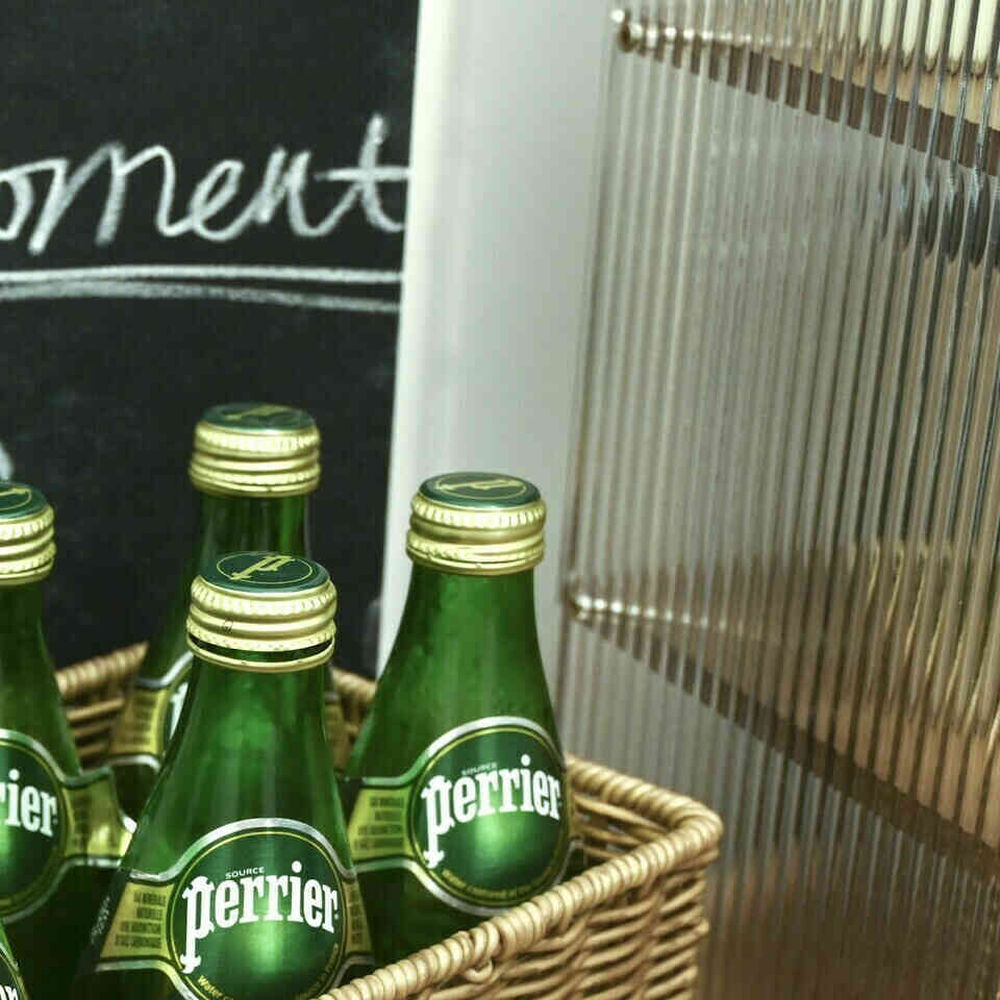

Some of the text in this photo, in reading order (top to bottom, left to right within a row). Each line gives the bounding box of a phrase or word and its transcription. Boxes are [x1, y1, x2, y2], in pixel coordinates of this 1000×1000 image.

[421, 754, 561, 868] perrier
[180, 861, 338, 974] perrier
[225, 866, 265, 880] SOURCE
